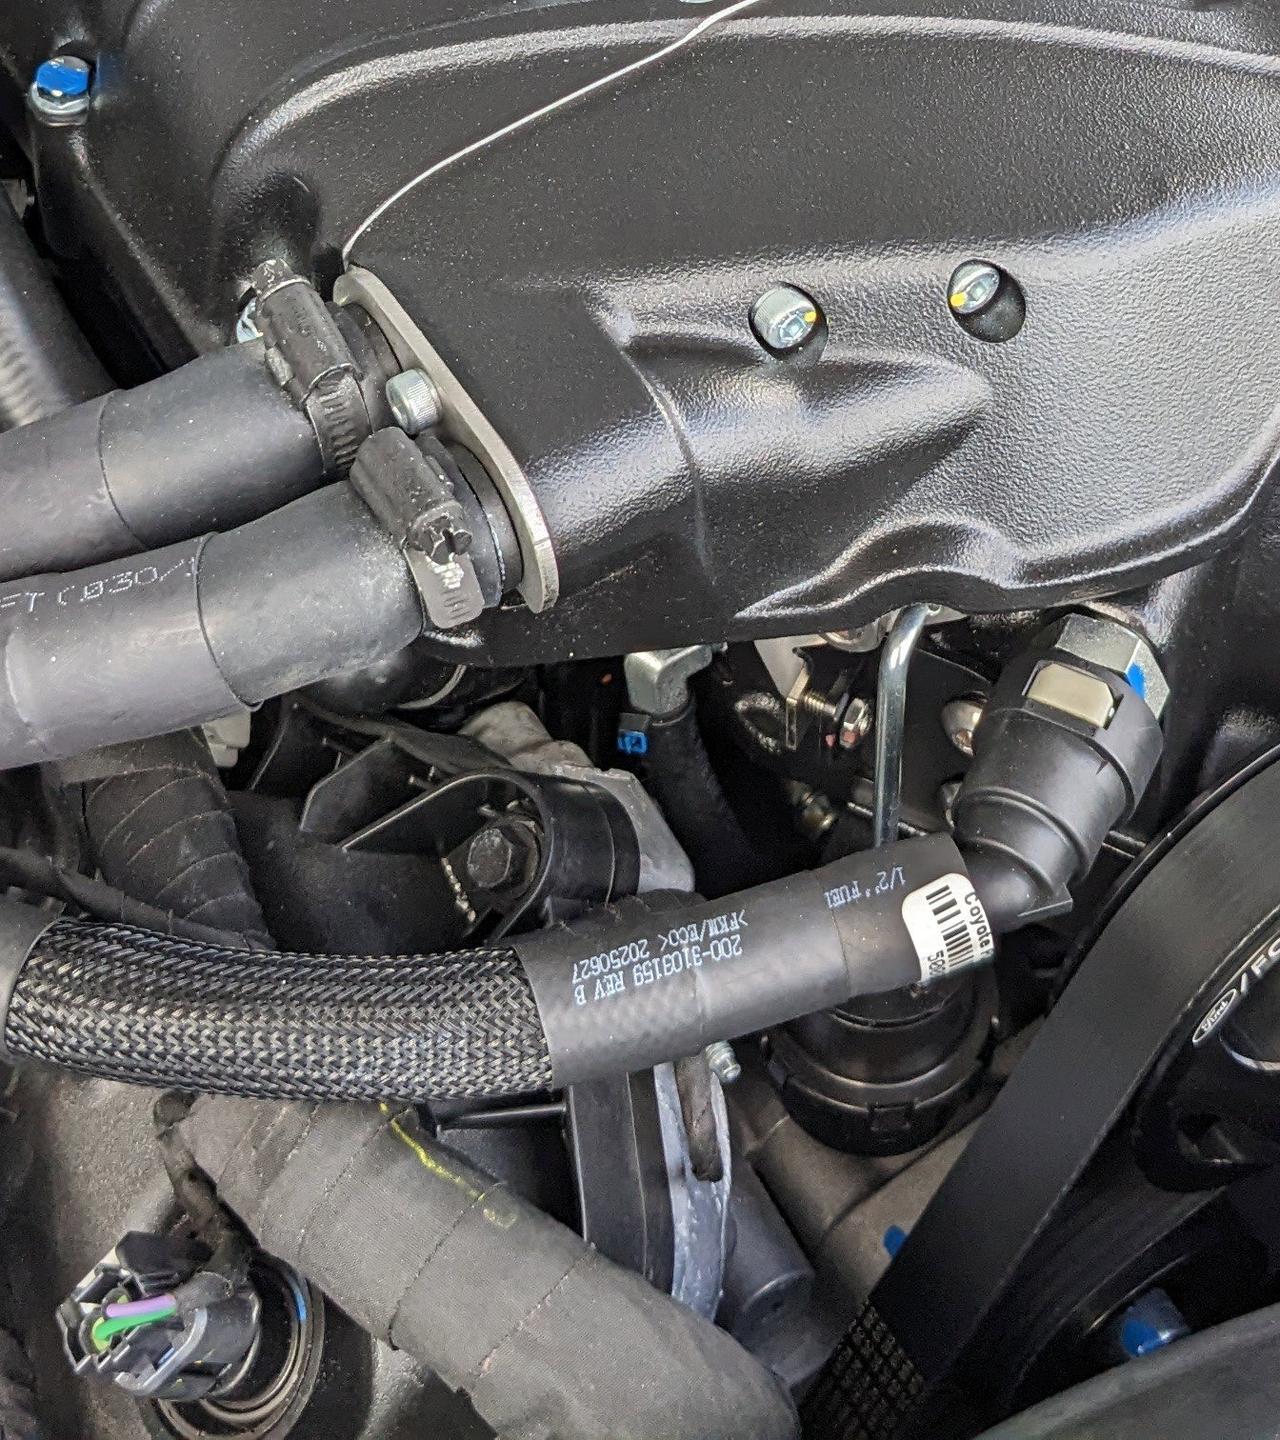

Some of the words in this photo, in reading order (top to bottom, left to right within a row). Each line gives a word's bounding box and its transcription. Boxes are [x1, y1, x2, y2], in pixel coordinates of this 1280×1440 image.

[964, 891, 992, 948] Coyote
[572, 939, 650, 984] 20250627
[633, 934, 743, 986] 200-3103159
[574, 984, 586, 1005] B
[594, 971, 625, 1000] REV
